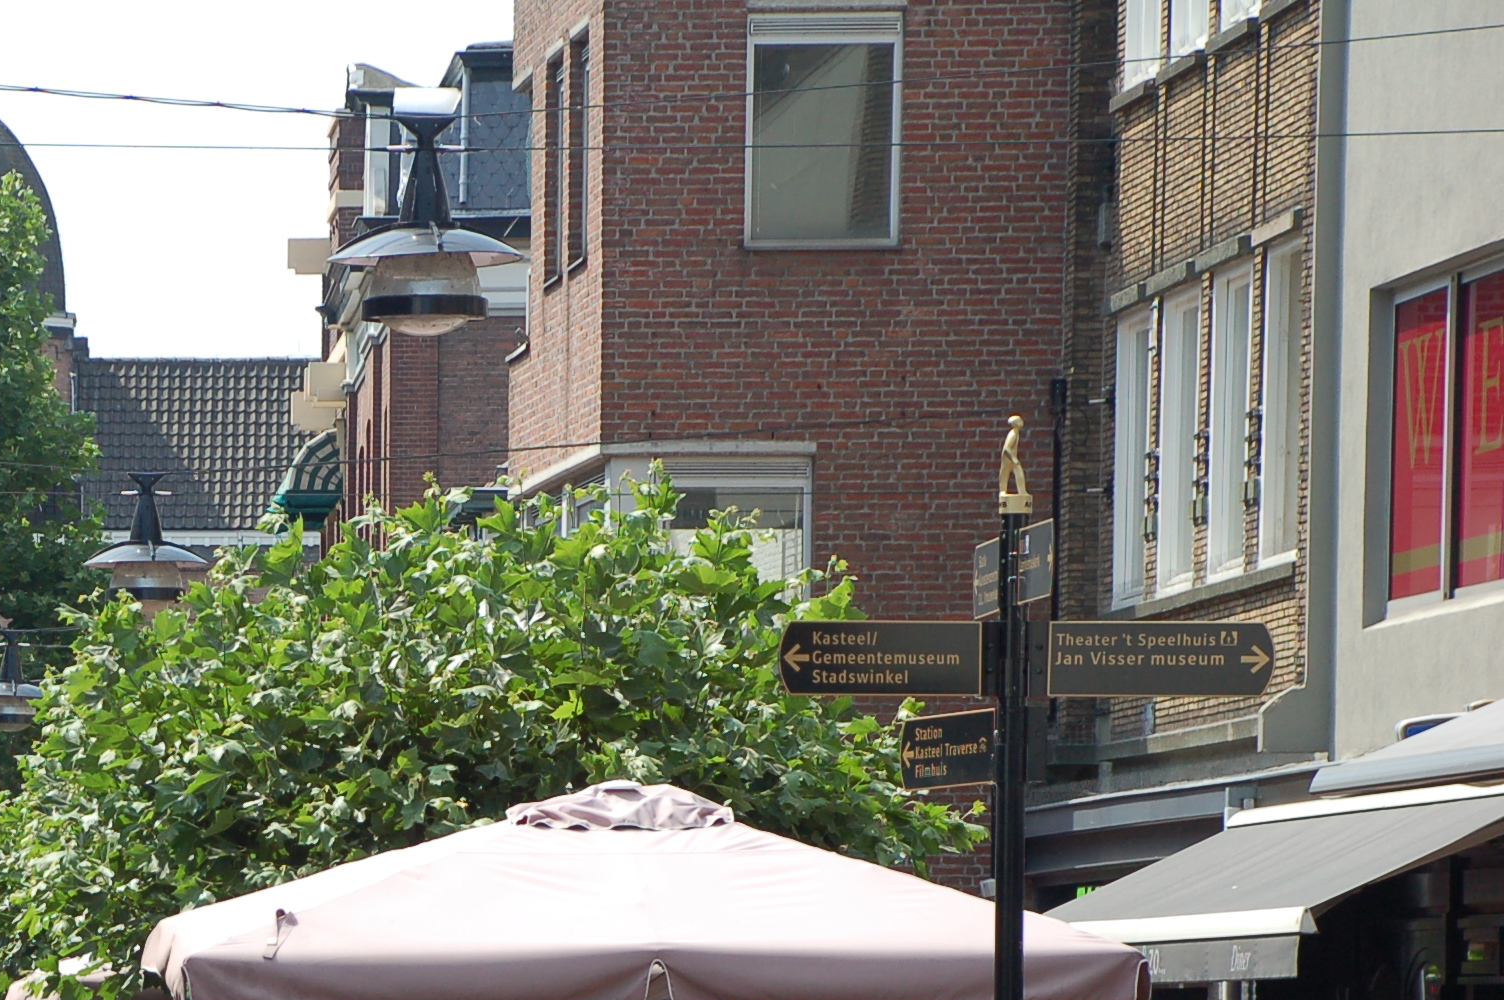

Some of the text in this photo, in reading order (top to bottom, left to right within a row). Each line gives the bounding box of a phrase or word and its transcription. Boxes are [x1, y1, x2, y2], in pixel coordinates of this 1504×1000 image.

[812, 630, 878, 646] Kasteel/
[1056, 632, 1216, 649] Theater 't Speelhuis
[812, 650, 960, 665] Gemeentemuseum
[1055, 651, 1225, 666] Jan Visser museum
[811, 668, 909, 684] Stadswinkel
[915, 725, 943, 741] Station
[915, 742, 978, 760] Kasteel Traverse
